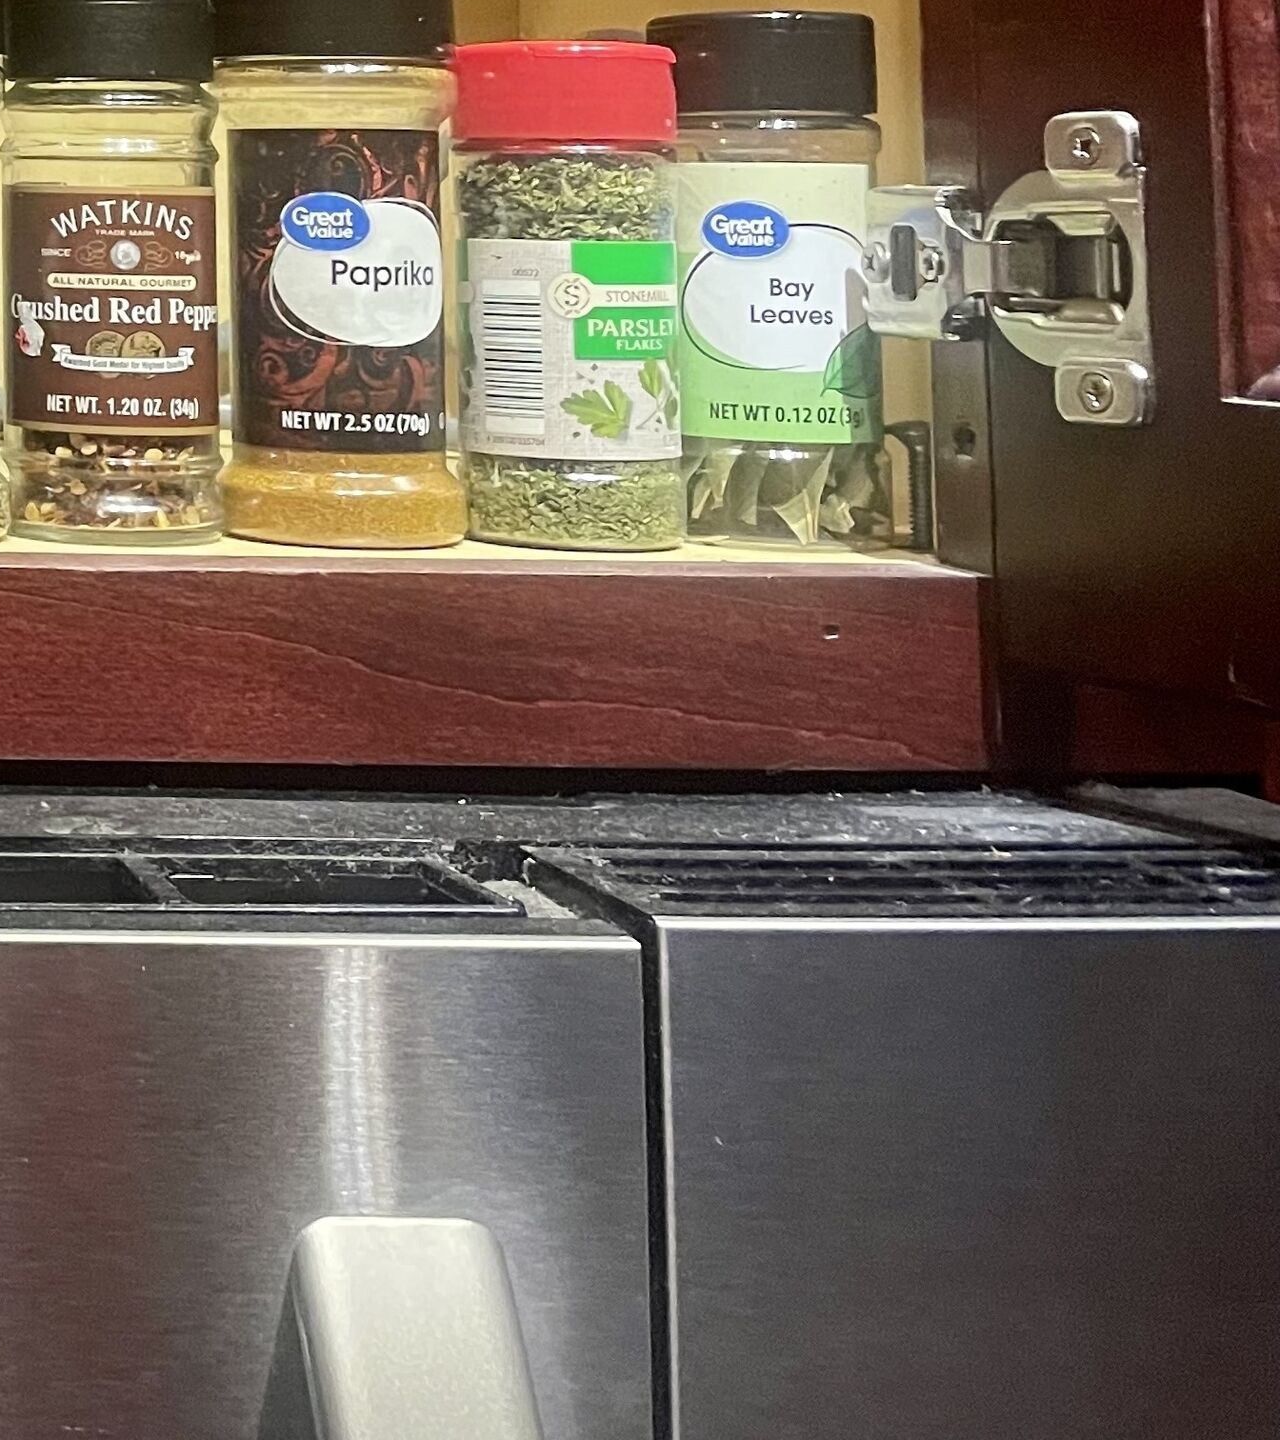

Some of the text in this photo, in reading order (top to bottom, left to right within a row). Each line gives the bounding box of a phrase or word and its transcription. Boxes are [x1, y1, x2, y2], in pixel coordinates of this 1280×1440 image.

[51, 199, 194, 241] WATKINS
[292, 207, 353, 227] Great
[711, 214, 774, 236] Great
[307, 225, 353, 239] Value
[725, 234, 774, 247] Value
[53, 276, 192, 288] ALL NATURAL GOURMET
[331, 260, 434, 292] Paprika
[606, 290, 669, 303] STONEMILL
[769, 278, 814, 302] Bay
[108, 297, 162, 324] Red
[750, 304, 833, 325] Leaves
[616, 340, 662, 351] FLAKES
[46, 394, 199, 420] NET WT. 1.20 OZ. (34g)
[710, 402, 738, 420] NET
[744, 405, 770, 422] WT
[775, 407, 812, 423] 0.12
[817, 409, 836, 424] OZ
[281, 411, 430, 436] NET WT 2.5 OZ (70g)
